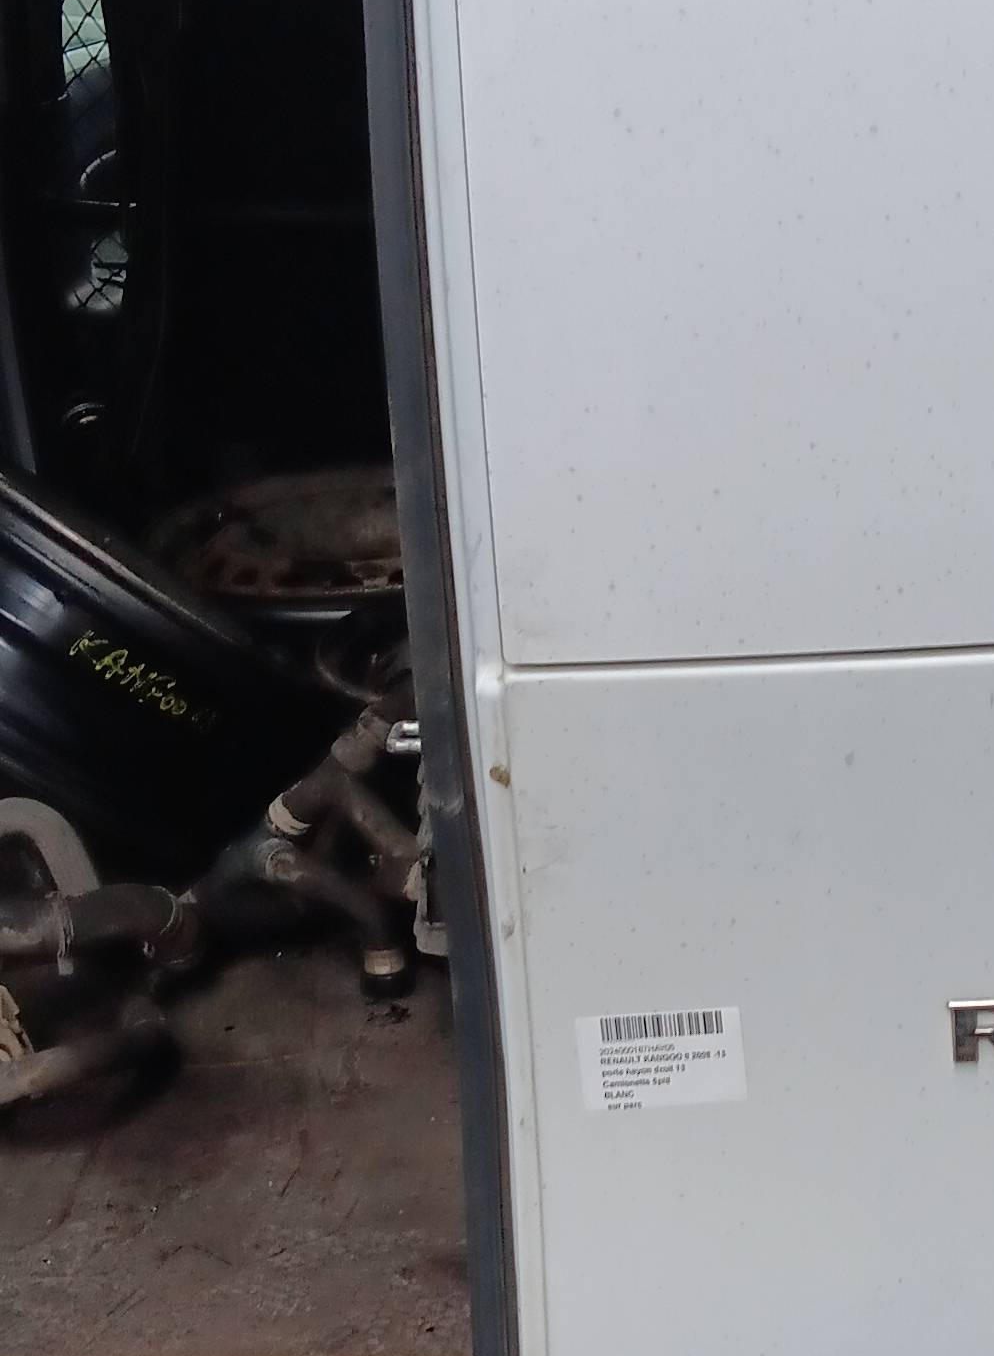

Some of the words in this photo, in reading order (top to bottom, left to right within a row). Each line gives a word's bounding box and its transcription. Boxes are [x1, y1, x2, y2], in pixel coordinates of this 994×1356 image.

[600, 1055, 641, 1065] RENAULT
[643, 1051, 683, 1063] KANGOO
[604, 1090, 635, 1100] BLANC
